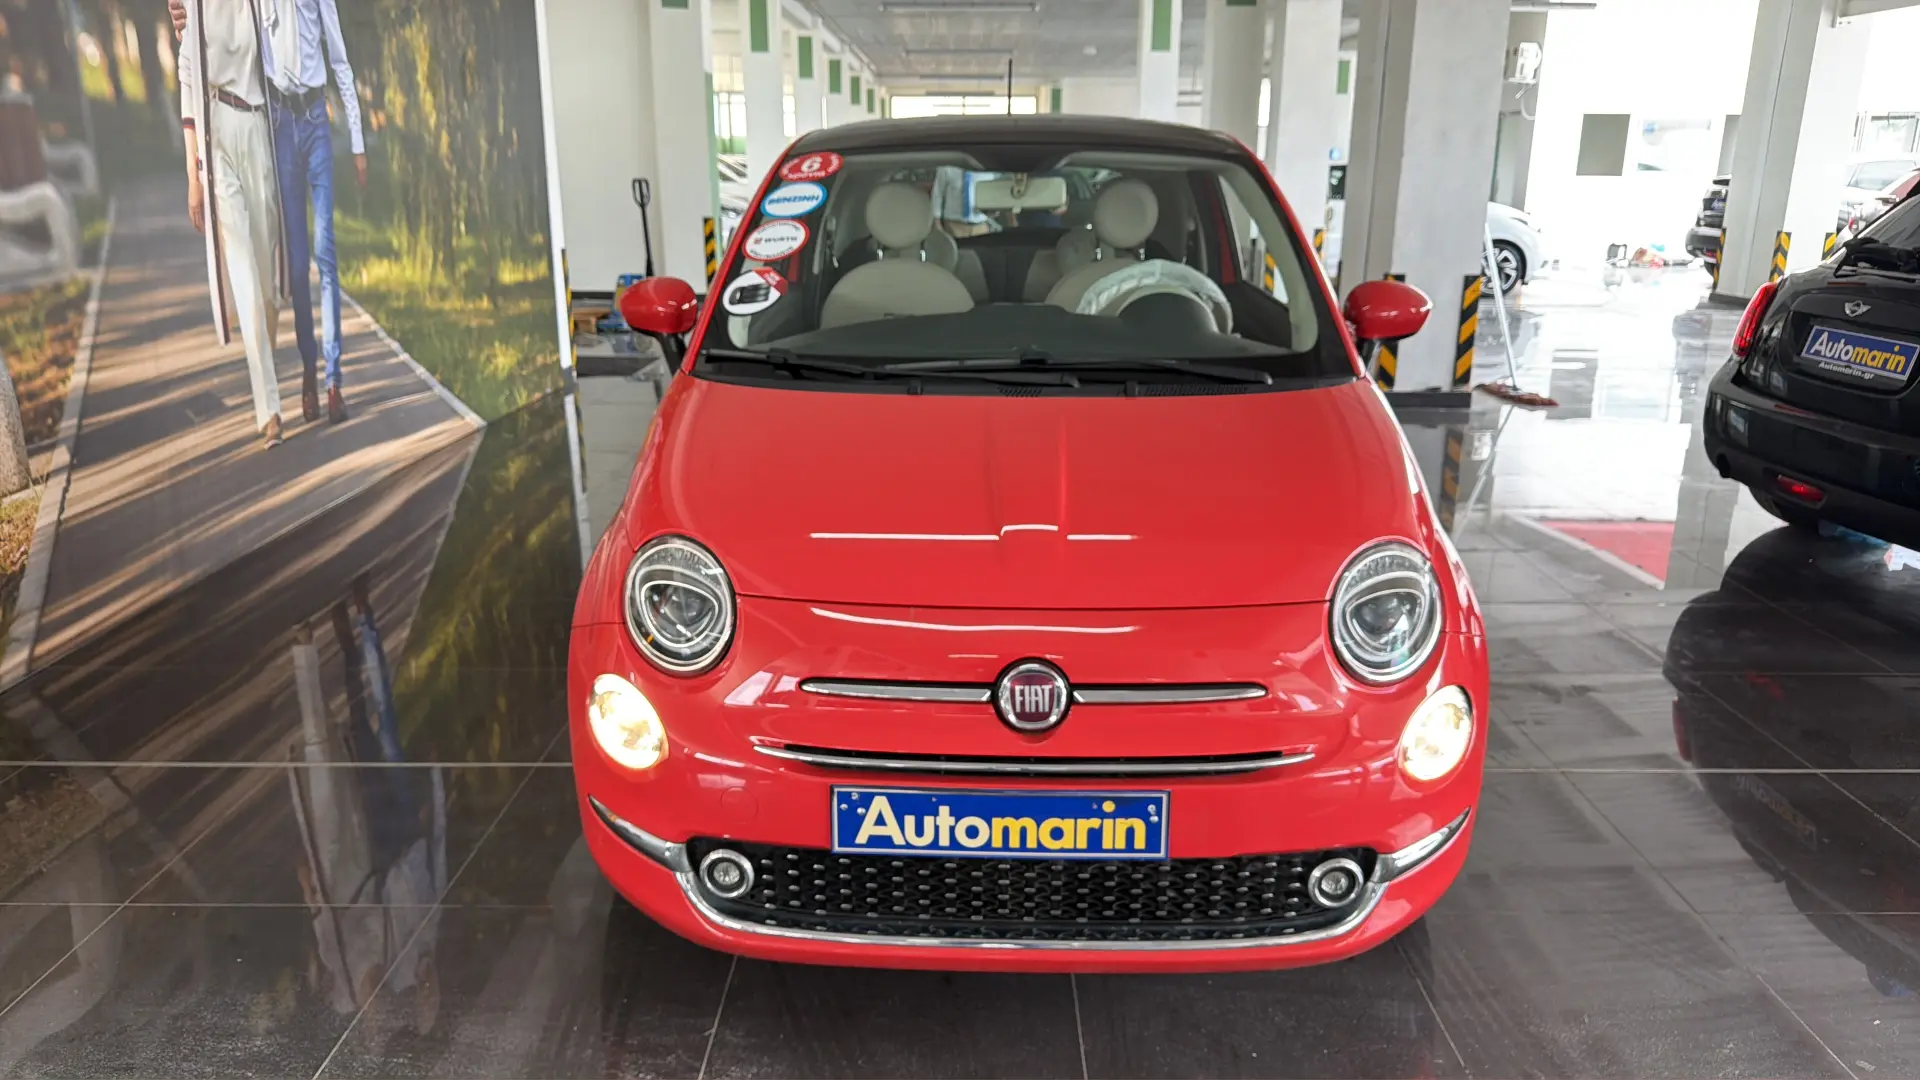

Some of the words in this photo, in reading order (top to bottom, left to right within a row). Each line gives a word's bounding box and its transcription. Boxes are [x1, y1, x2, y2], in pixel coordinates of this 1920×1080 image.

[1809, 331, 1906, 373] Automarin
[1819, 360, 1875, 380] Automarin.gr
[1015, 685, 1052, 713] FIAT
[854, 795, 1146, 849] Automarin
